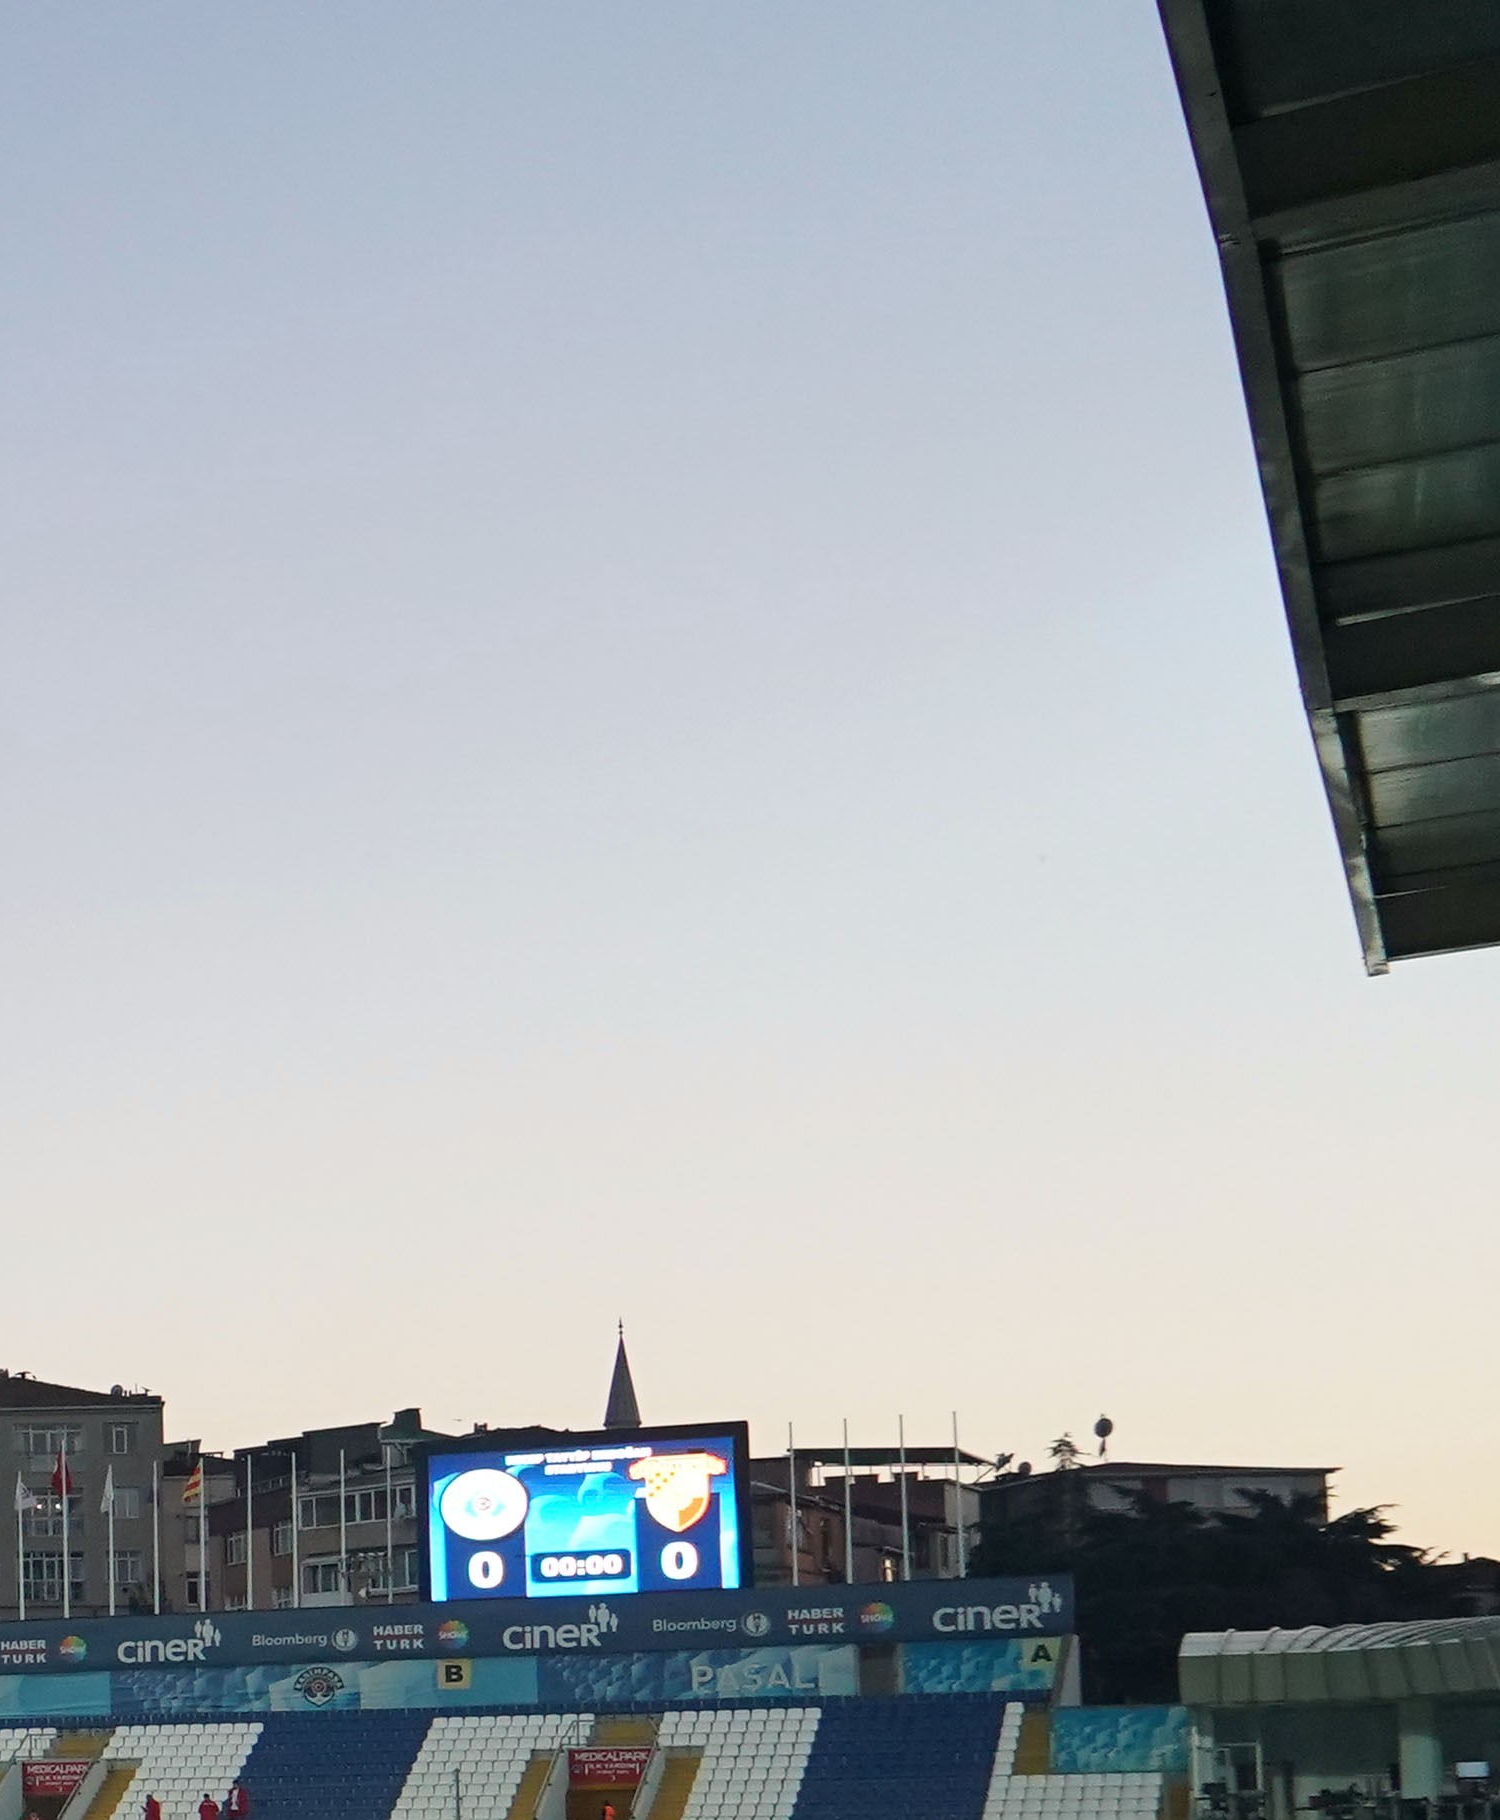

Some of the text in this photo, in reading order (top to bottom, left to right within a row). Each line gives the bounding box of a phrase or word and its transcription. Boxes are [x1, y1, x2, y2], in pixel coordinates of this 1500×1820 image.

[468, 1541, 698, 1589] 0 00:00 0
[787, 1607, 844, 1621] HABER
[373, 1624, 424, 1636] HABER
[652, 1618, 737, 1634] Bloomberg
[0, 1639, 46, 1650] HABER
[252, 1633, 327, 1648] Bloomberg
[1031, 1644, 1053, 1662] A
[445, 1664, 463, 1683] B
